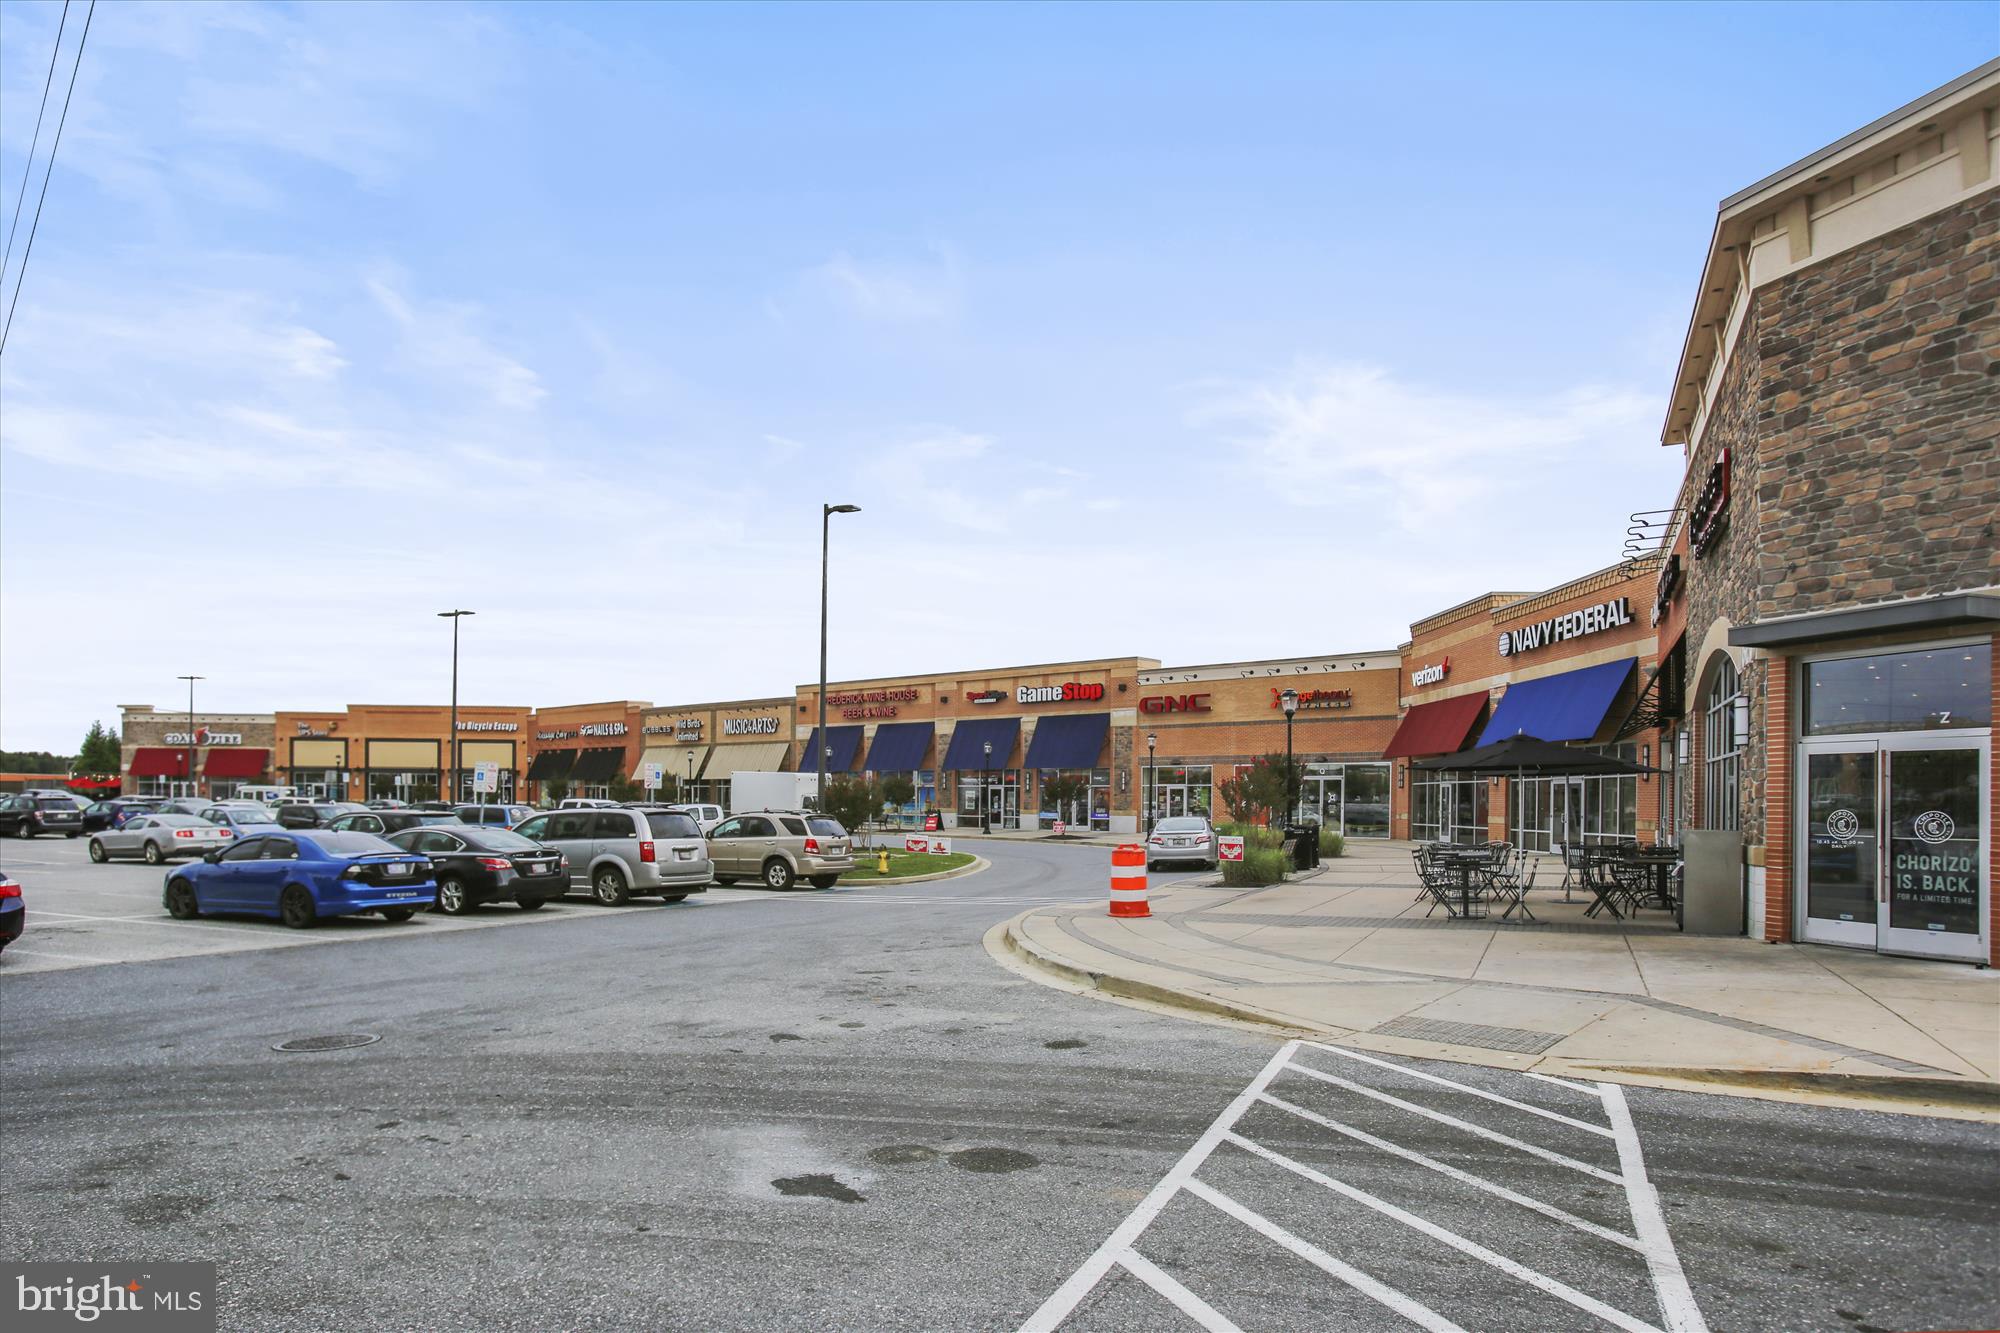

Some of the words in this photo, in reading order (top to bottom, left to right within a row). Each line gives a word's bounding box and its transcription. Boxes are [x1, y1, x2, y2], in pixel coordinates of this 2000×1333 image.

[1512, 618, 1553, 654] NAVY
[1555, 597, 1630, 642] FEDERAL
[1411, 662, 1443, 687] verizon
[827, 693, 864, 705] REDERICK
[867, 692, 885, 702] WINE
[888, 689, 916, 700] HOUSE
[1016, 682, 1103, 703] GameStop
[1139, 694, 1211, 714] GNC
[843, 707, 862, 719] BEER
[876, 706, 895, 717] WINE
[1939, 711, 1951, 724] Z
[467, 721, 492, 732] Bicycle
[494, 721, 518, 732] Escape
[593, 723, 608, 736] NAILS
[614, 722, 624, 736] SPA
[1918, 813, 1951, 825] CHIPOTLE
[1897, 874, 1918, 889] IS.
[1922, 875, 1976, 893] BACK.
[1920, 895, 1951, 903] LIMITED
